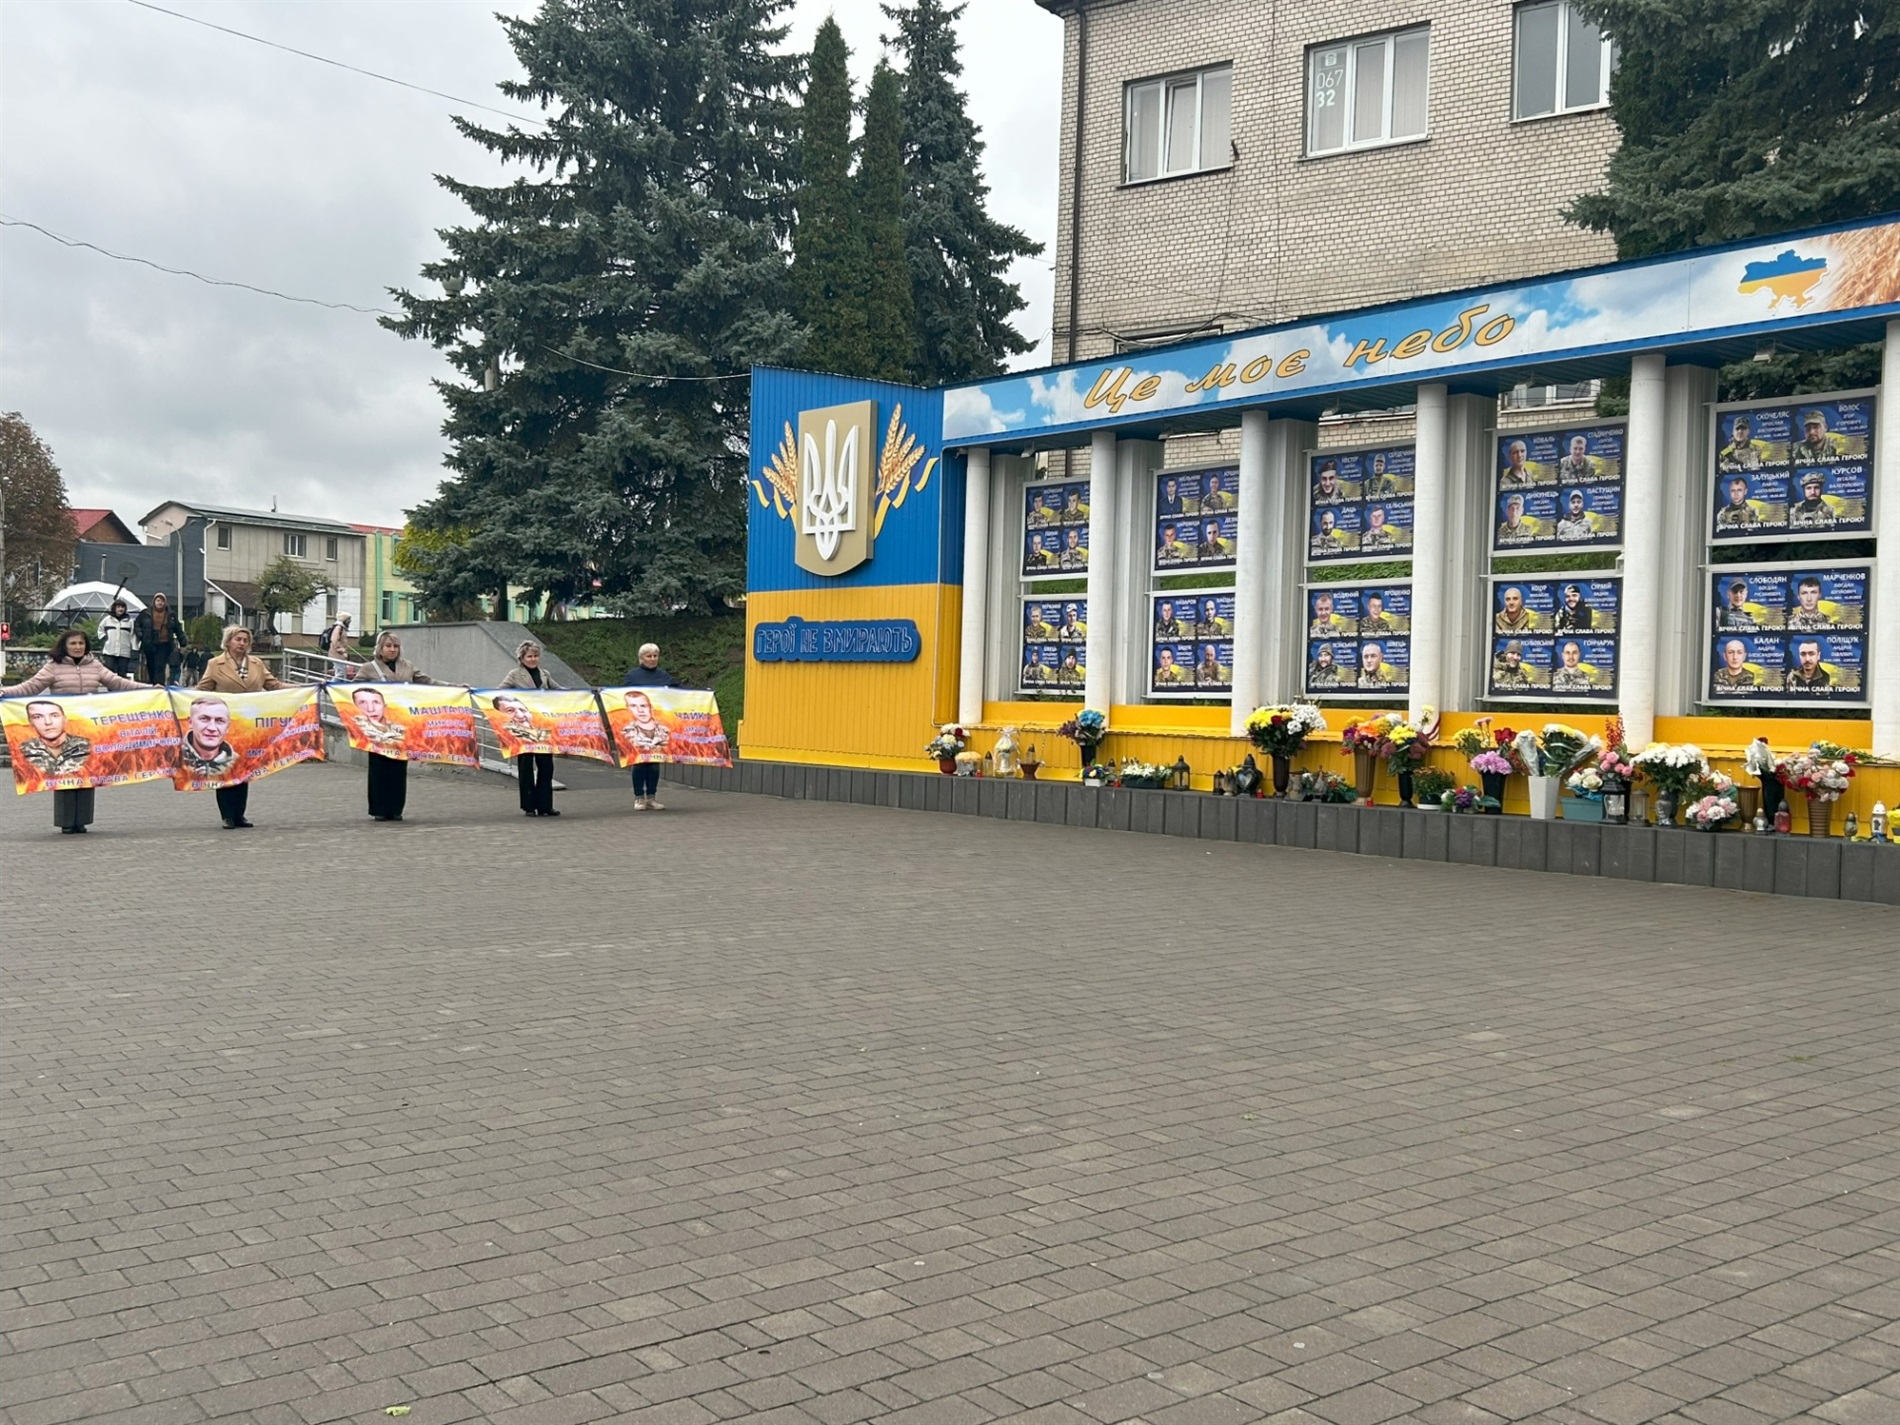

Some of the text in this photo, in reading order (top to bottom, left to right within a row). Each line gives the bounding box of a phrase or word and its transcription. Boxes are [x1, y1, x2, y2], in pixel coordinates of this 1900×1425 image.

[1316, 70, 1343, 89] 067
[1316, 89, 1335, 108] 32
[1084, 304, 1516, 413] Це моє небо
[1832, 467, 1862, 475] КУРСОВ
[1823, 573, 1865, 581] МАРЧЕНКОВ
[757, 624, 912, 654] ГЕРОЇ НЕ ВМИРАЮТЬ
[91, 710, 174, 725] ТЕРЕЩЕНКО
[95, 738, 180, 752] ВОЛОДИМИРОВИ
